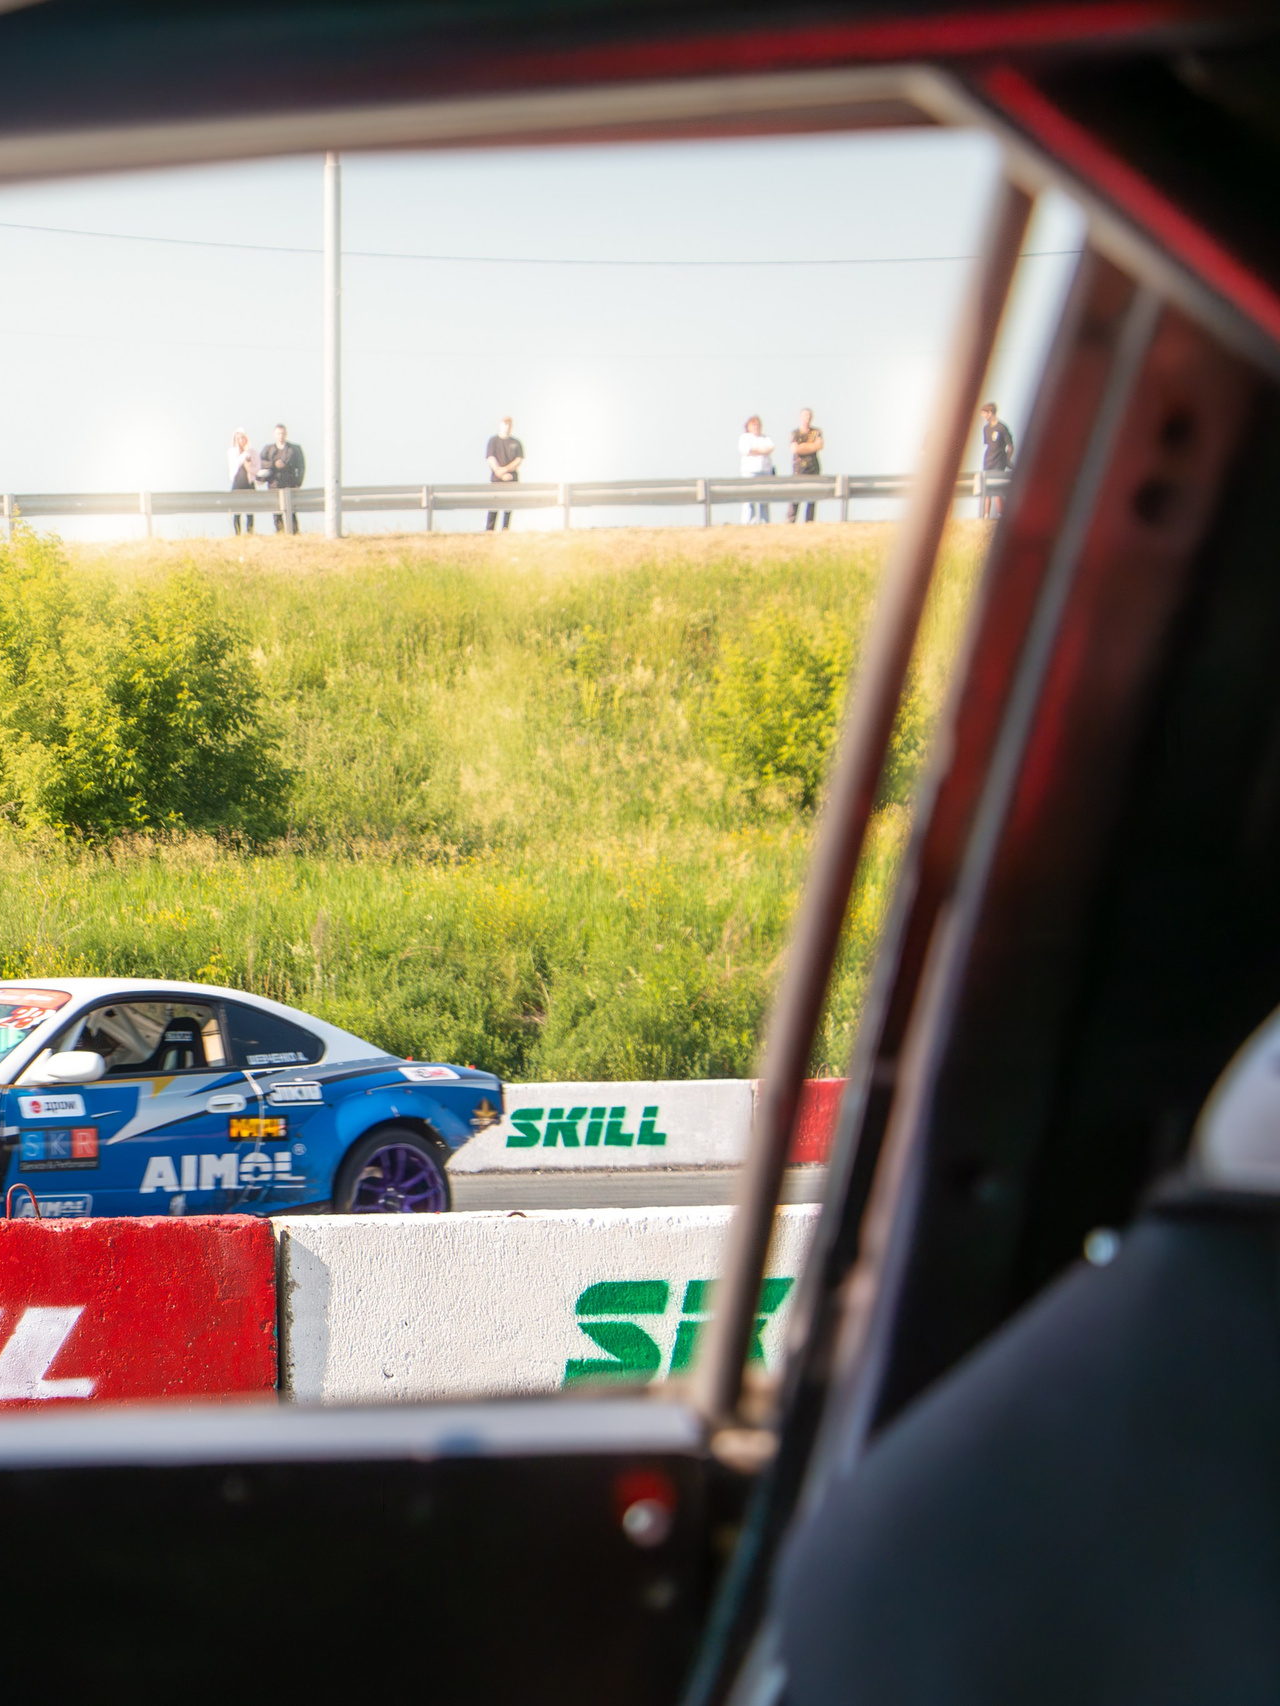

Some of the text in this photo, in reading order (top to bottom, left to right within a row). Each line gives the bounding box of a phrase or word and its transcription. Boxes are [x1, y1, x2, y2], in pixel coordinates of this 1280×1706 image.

[25, 1132, 95, 1157] SKR
[506, 1106, 667, 1148] SKILL
[139, 1151, 307, 1194] AIMOL
